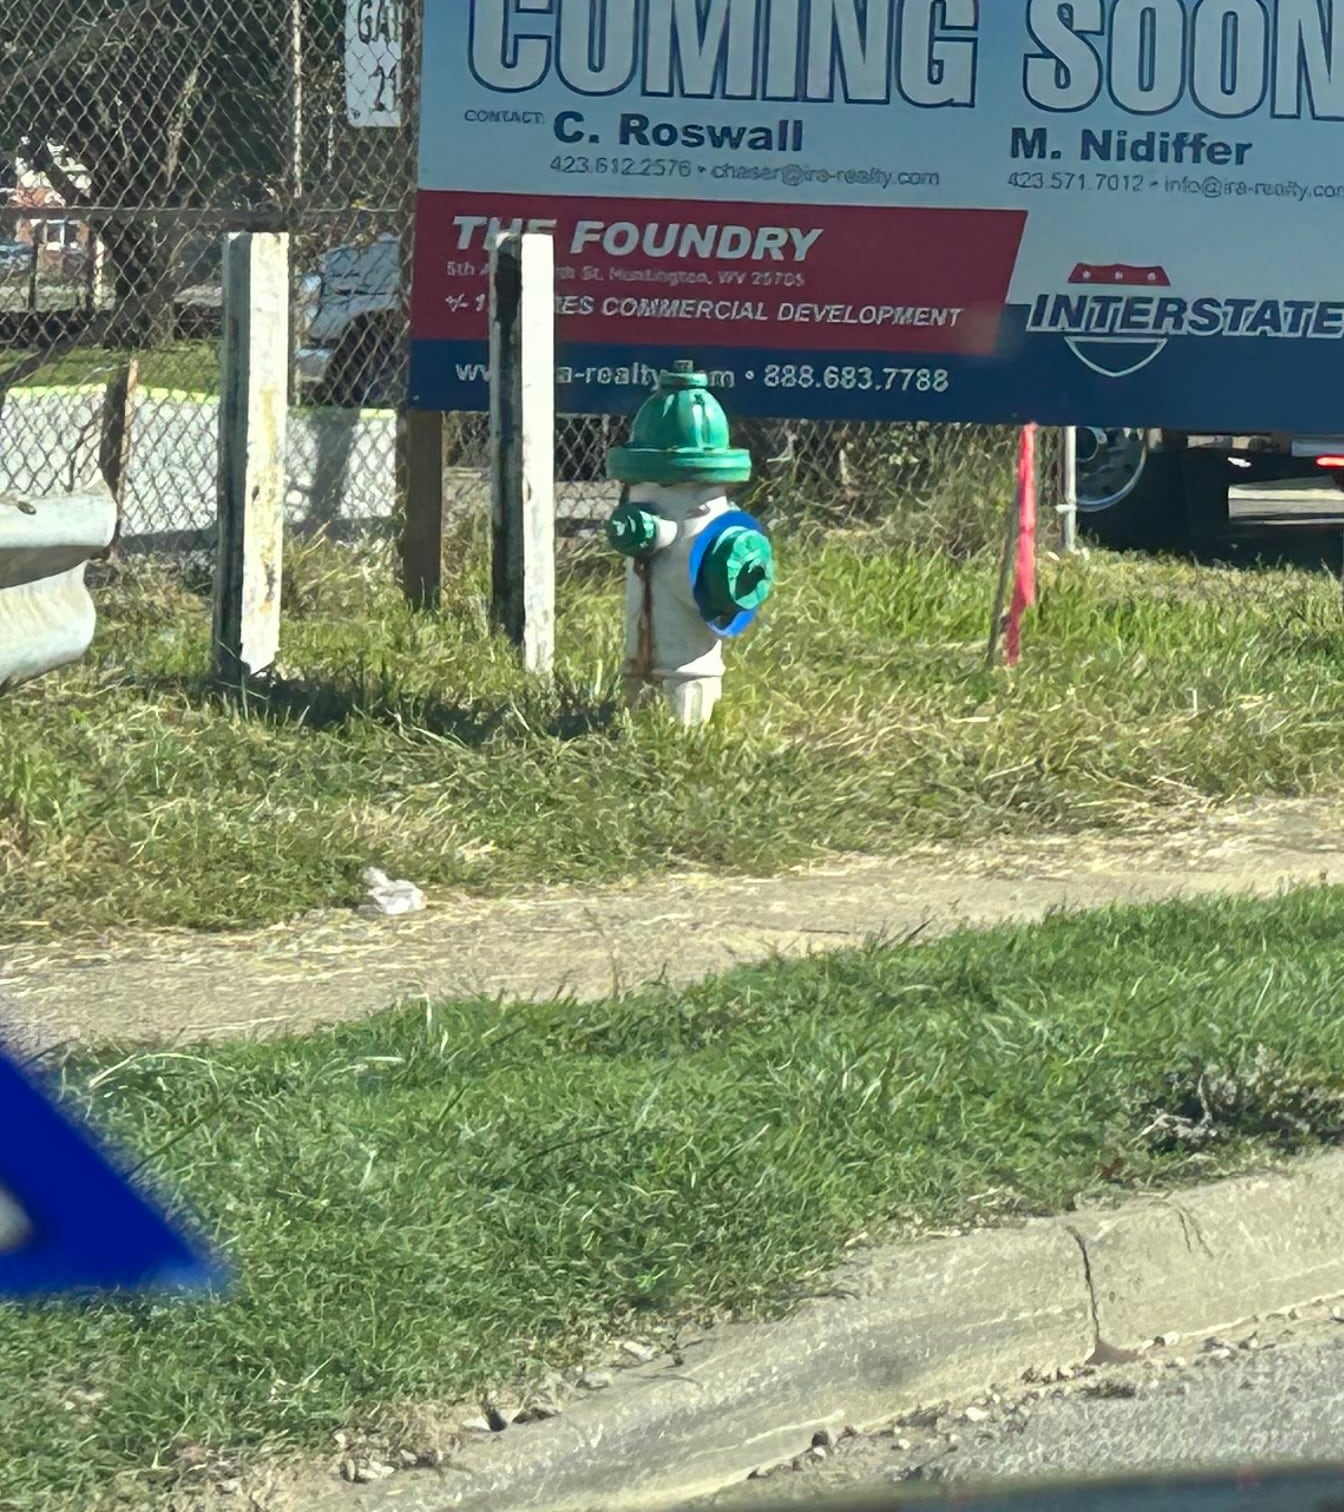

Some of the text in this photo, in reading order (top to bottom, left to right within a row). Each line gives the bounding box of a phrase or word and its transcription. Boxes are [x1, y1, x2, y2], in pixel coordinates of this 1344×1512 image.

[553, 110, 600, 144] C.
[619, 113, 803, 152] Roswall
[1010, 127, 1253, 166] M. Nidiffer
[569, 220, 824, 261] FOUNDRY
[602, 296, 769, 321] COMMERCIAL
[777, 302, 965, 327] DEVELOPMENT
[764, 364, 950, 392] 888.683.7788
